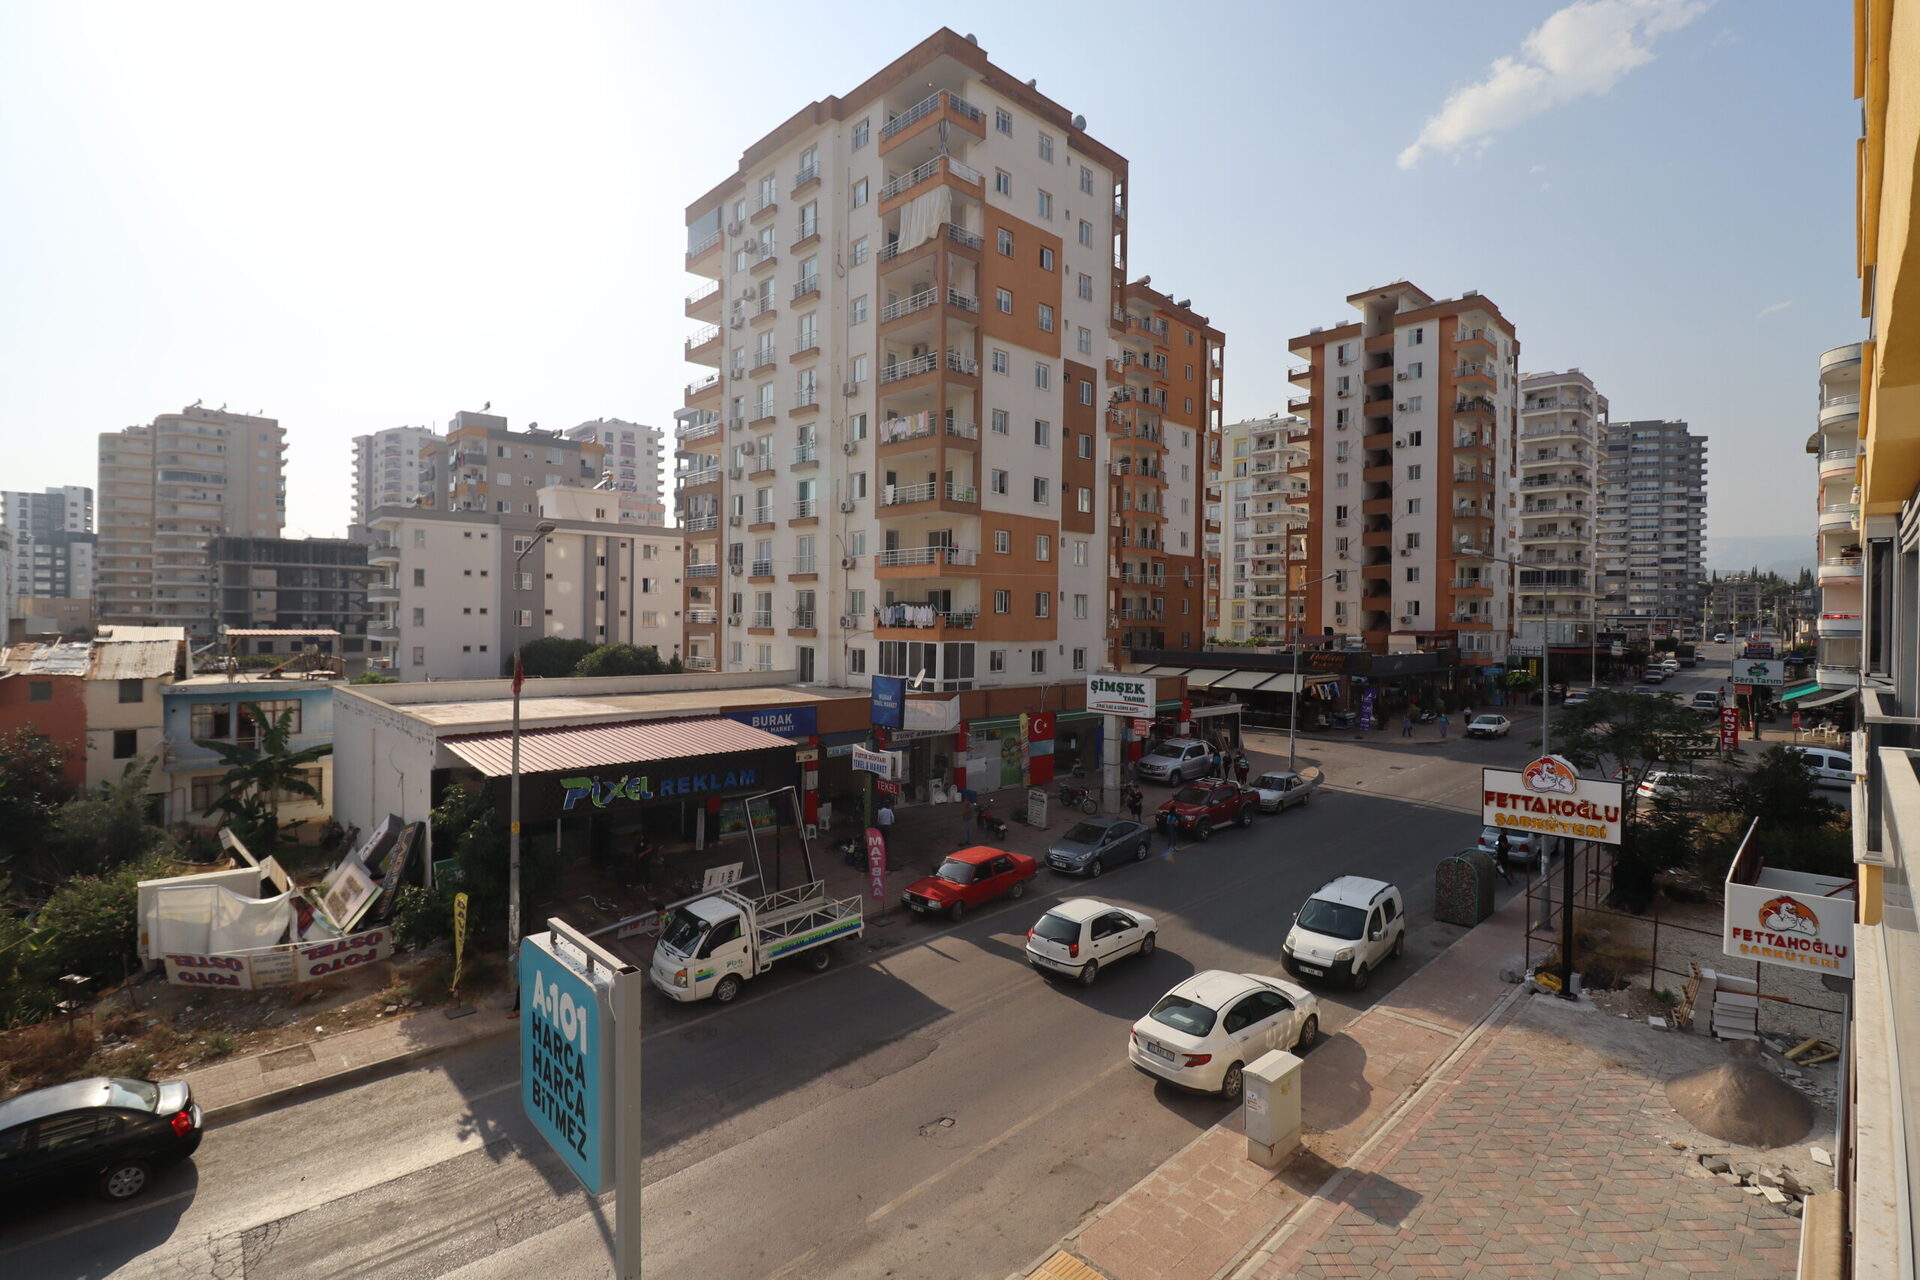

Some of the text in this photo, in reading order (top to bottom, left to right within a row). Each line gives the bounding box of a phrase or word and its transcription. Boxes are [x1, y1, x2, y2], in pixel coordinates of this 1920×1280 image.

[1090, 678, 1146, 696] ŞİMŞEK
[1734, 676, 1754, 684] Sera
[1123, 695, 1145, 703] TARIM
[751, 713, 793, 728] BURAK
[770, 724, 795, 734] MARKET
[853, 759, 866, 769] TEKEL
[869, 762, 887, 774] MARKET
[660, 769, 756, 797] REKLAM
[876, 780, 898, 795] TEKEL
[1484, 790, 1620, 822] FETTAHOĞLU
[868, 836, 884, 897] MATBAA
[1732, 927, 1848, 958] FETTAHOĞLU
[309, 948, 378, 977] FOTO
[178, 971, 241, 987] FOTO
[531, 1011, 587, 1090] HARCA
[531, 1044, 587, 1127] HARCA
